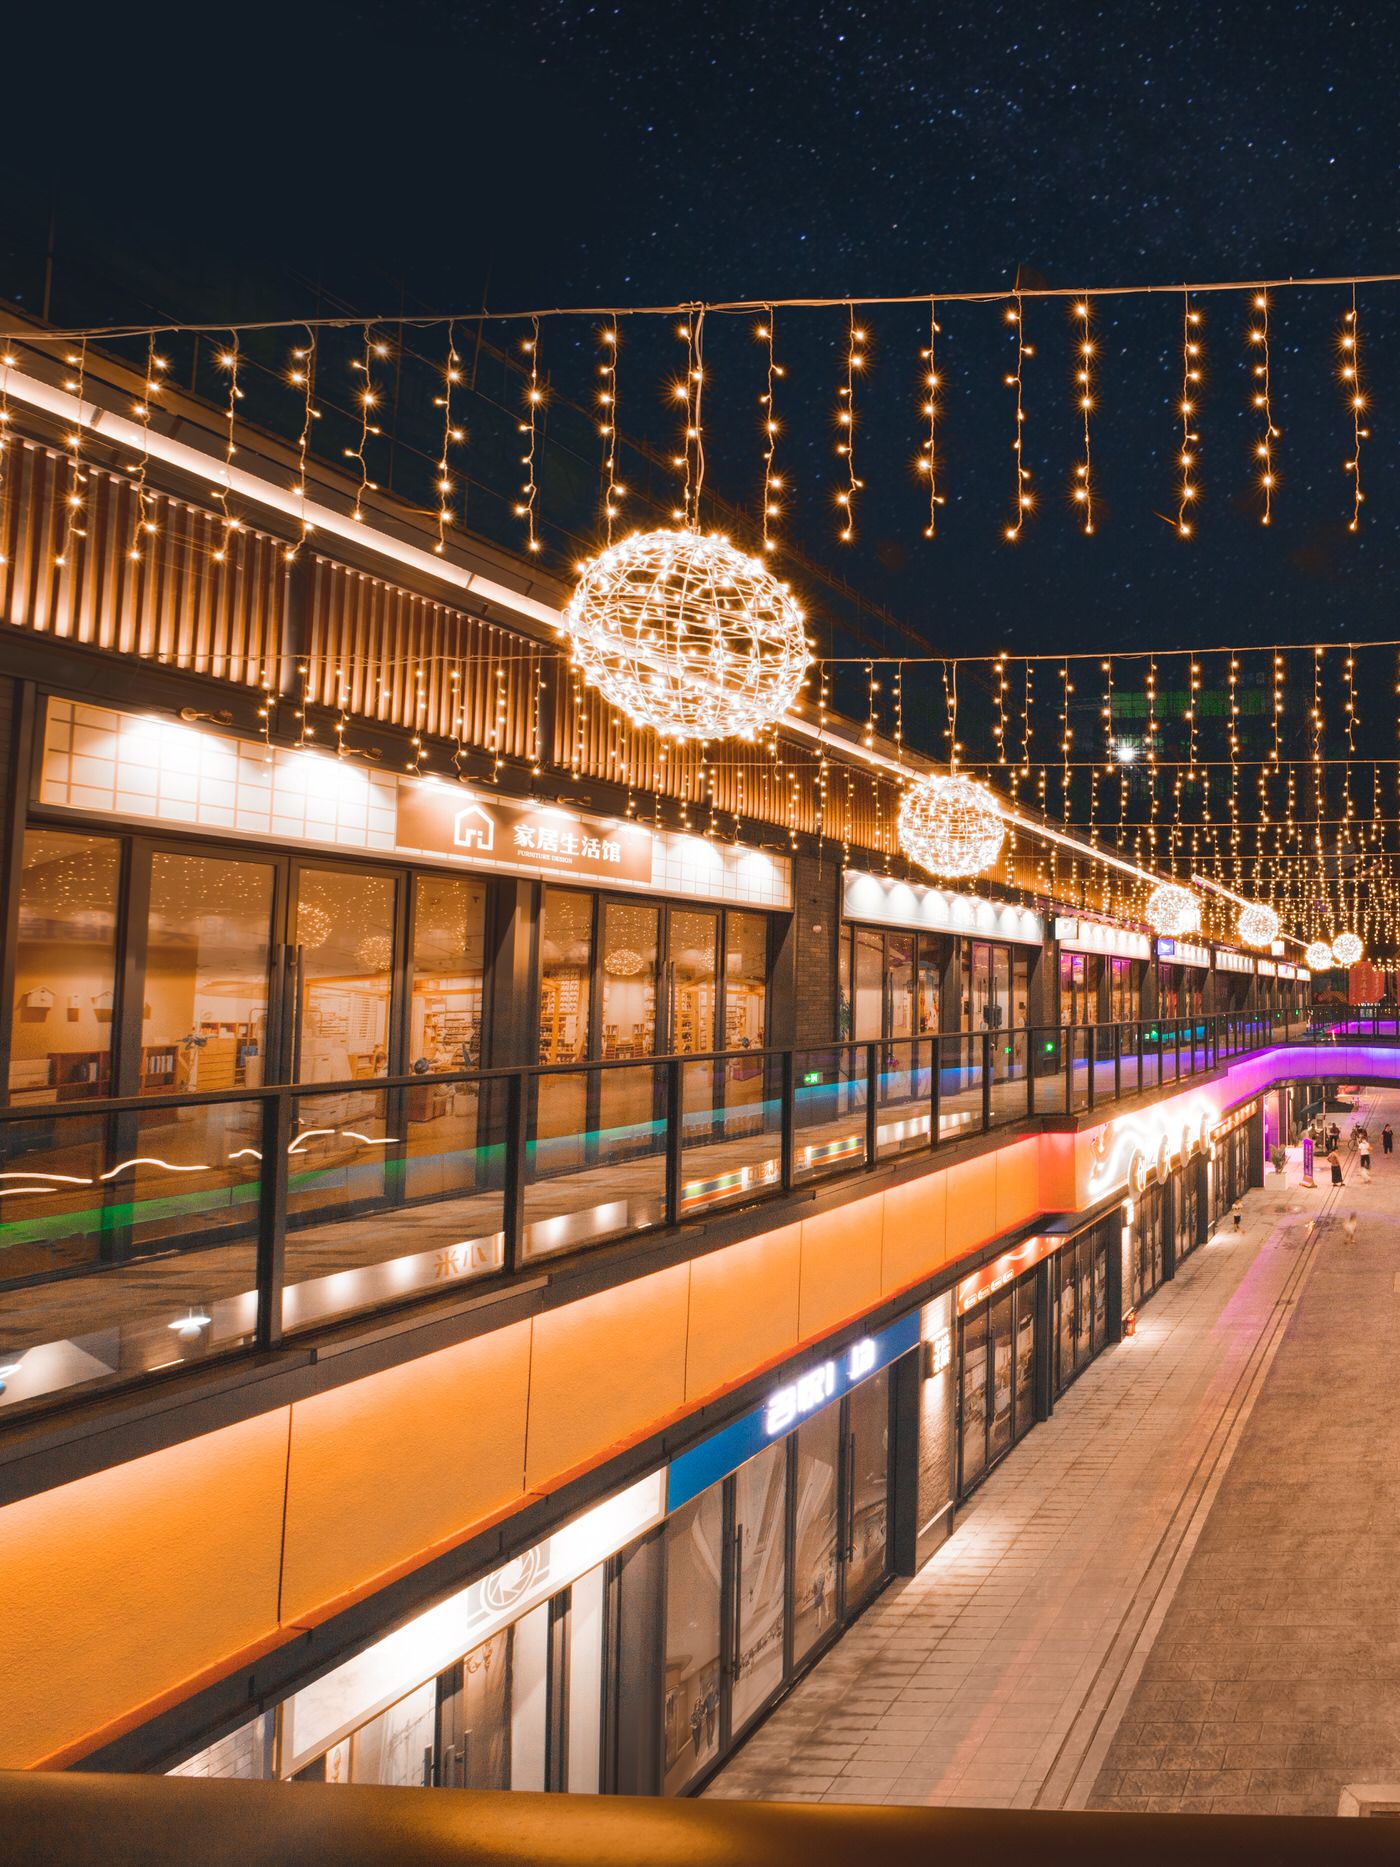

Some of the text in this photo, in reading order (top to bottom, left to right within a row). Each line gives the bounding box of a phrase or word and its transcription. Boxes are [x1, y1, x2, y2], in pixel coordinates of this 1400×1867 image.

[514, 825, 621, 863] 家居生活馆
[518, 850, 572, 864] FURNITURE DESIGN
